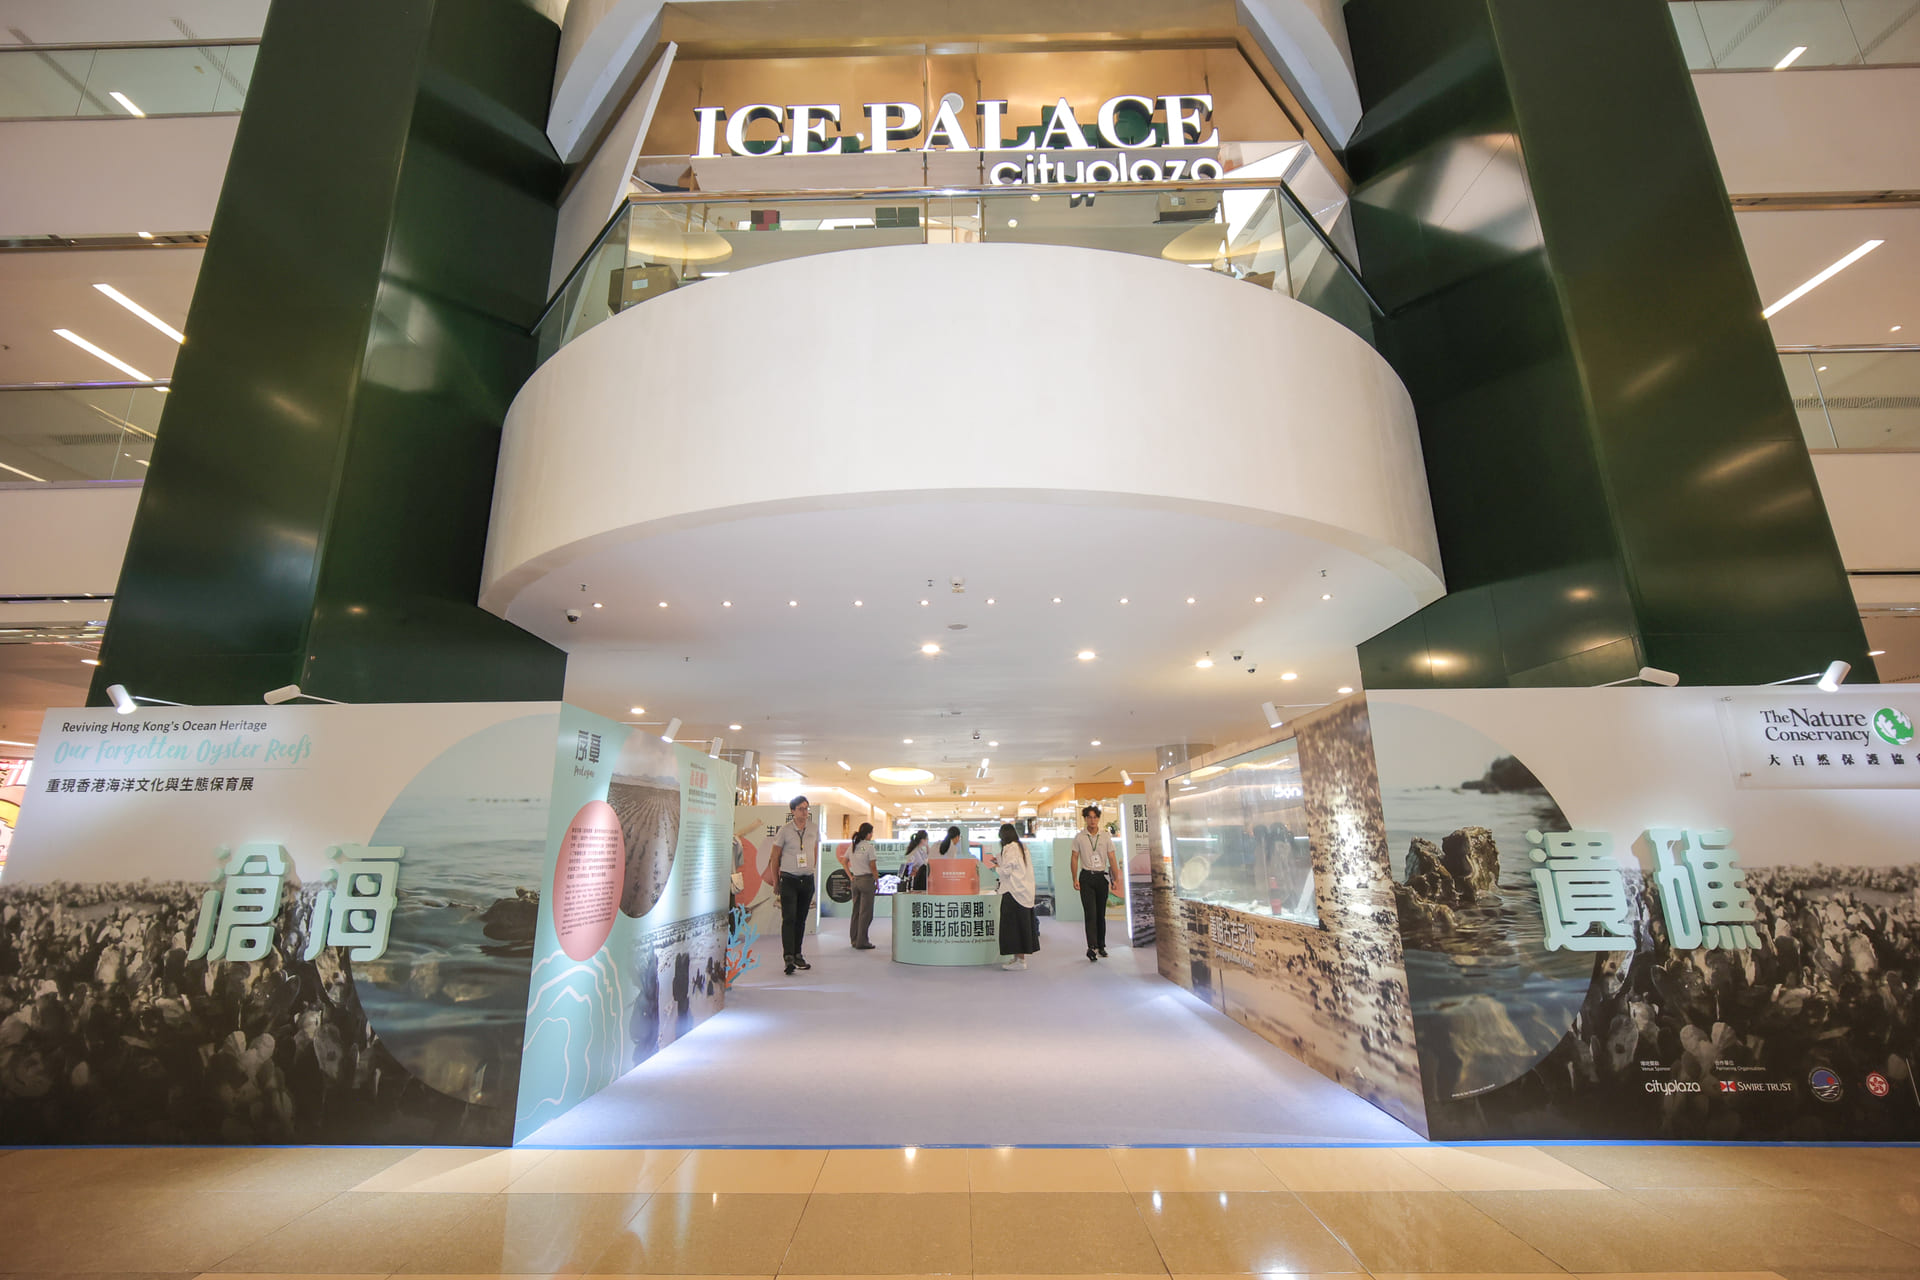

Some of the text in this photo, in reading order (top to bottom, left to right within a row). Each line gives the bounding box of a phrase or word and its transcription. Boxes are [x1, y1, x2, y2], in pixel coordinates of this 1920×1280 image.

[691, 94, 1219, 158] ICE PALACE
[62, 719, 267, 734] Reviving Hong Kong's Ocean Heritage
[1760, 707, 1868, 728] The Nature
[575, 730, 601, 764] 序章
[1764, 726, 1870, 747] Conservancy
[54, 733, 312, 765] Our Forgotten Oyster Reefs
[1768, 753, 1920, 766] 大自然保護協
[45, 776, 254, 793] 重現香港海洋文化與生態保育展
[1525, 827, 1762, 951] 遺礁
[187, 840, 405, 961] 滄海
[1645, 1080, 1701, 1095] cityplaza
[1737, 1081, 1792, 1091] SWIRE TRUST
